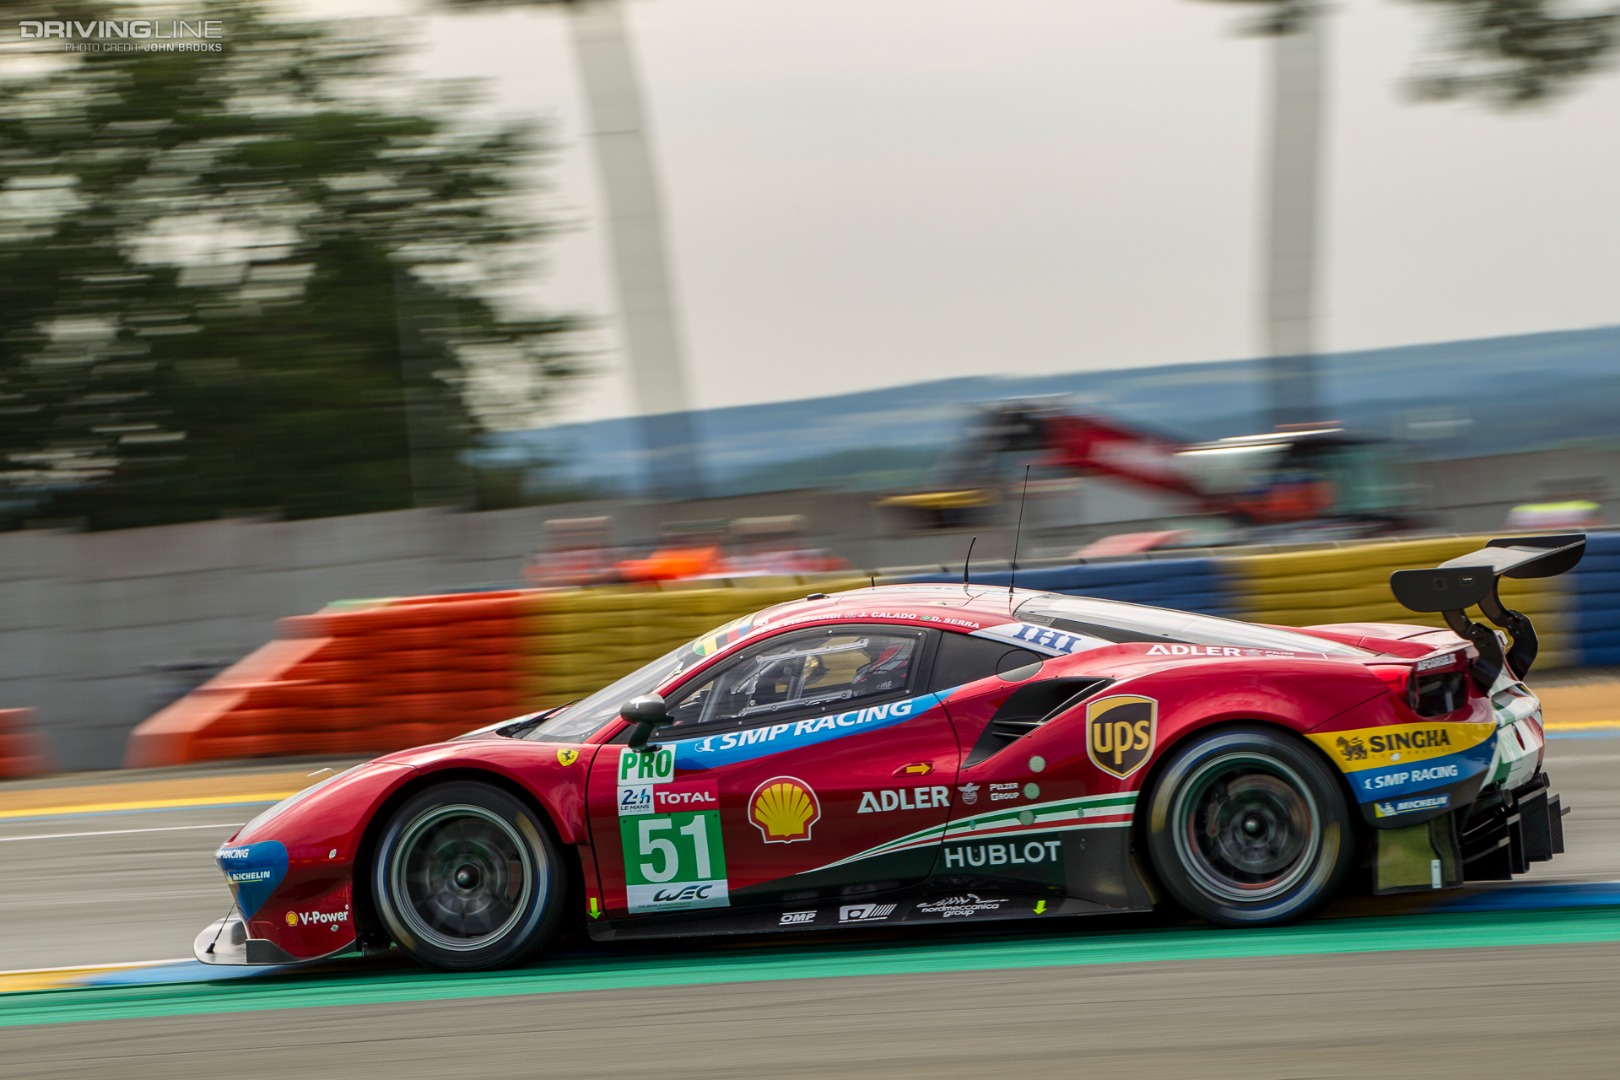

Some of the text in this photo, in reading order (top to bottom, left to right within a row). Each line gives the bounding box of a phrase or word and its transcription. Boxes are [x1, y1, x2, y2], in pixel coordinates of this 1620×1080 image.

[871, 611, 917, 620] CALADO
[930, 615, 943, 623] D.
[943, 617, 980, 630] SERRA
[1013, 624, 1082, 654] IHI
[1146, 644, 1242, 657] ADLER
[719, 699, 913, 750] SMP RACING
[1093, 719, 1151, 765] ups
[1368, 728, 1452, 753] SINGHA
[621, 748, 673, 781] PRO
[989, 782, 1019, 791] PELZER
[1374, 765, 1459, 789] SMP RACING
[655, 791, 716, 805] TOTAL
[857, 785, 951, 814] ADLER
[990, 792, 1020, 802] GROUP
[637, 814, 713, 883] 51
[944, 840, 1062, 868] HUBLOT
[653, 884, 713, 902] WEC
[298, 910, 349, 925] V-Power
[780, 912, 817, 923] OMP
[921, 903, 1000, 913] nordmeccanica
[942, 909, 975, 918] group
